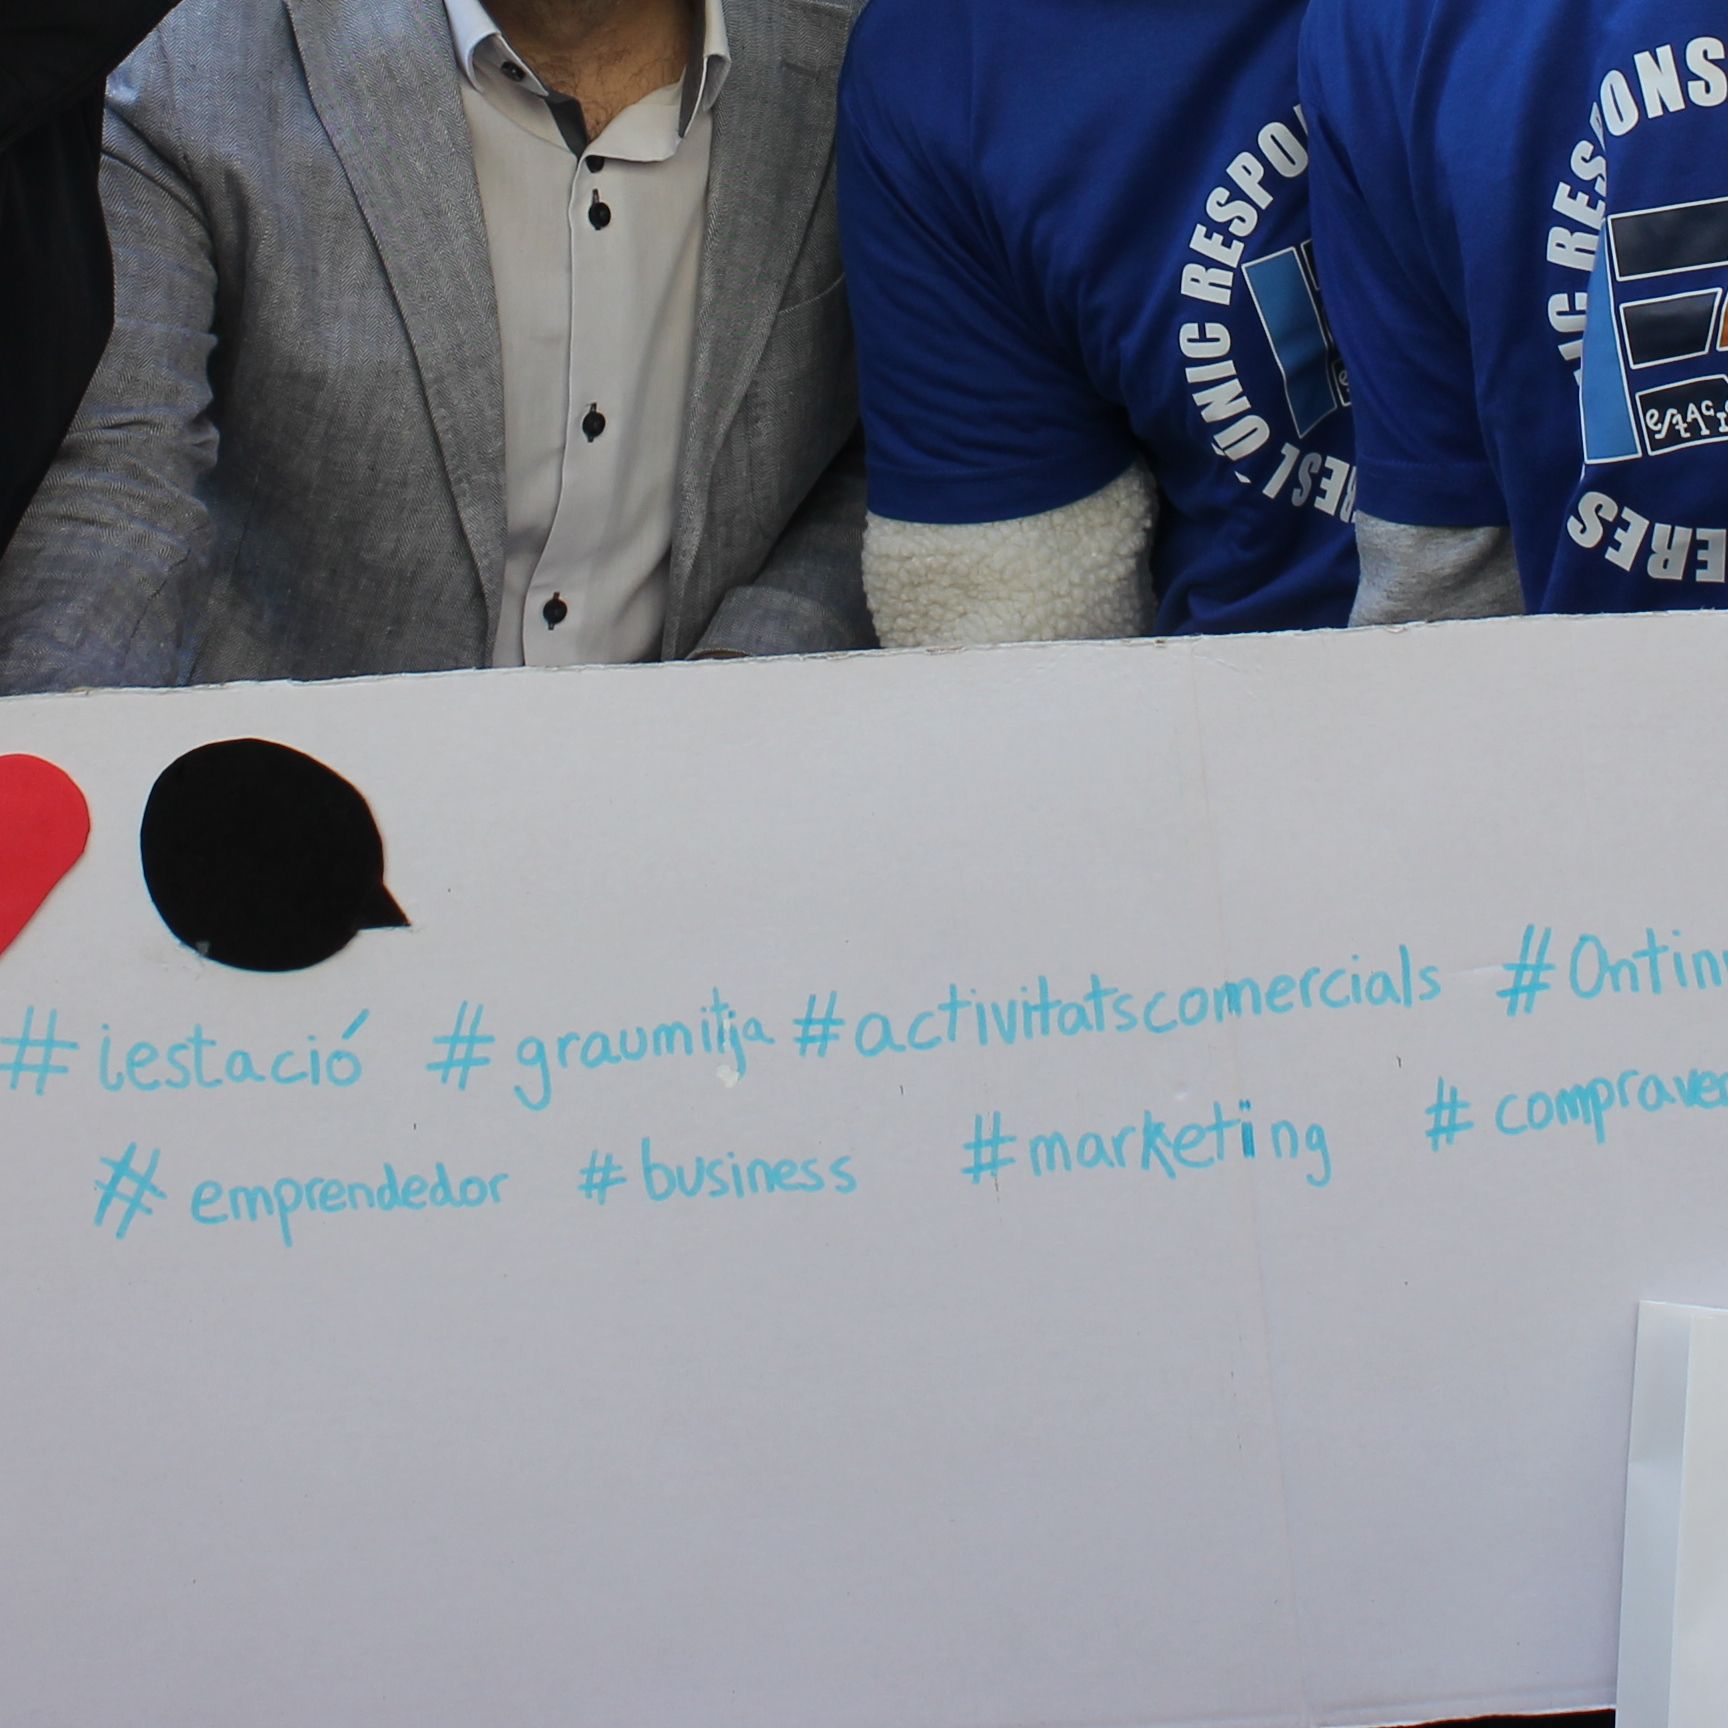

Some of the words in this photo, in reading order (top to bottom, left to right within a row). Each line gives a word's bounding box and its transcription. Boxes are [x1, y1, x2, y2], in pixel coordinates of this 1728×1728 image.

[1179, 103, 1309, 307] RESPO
[1566, 489, 1727, 583] ERES
[791, 944, 1442, 1059] #activitatscomercials
